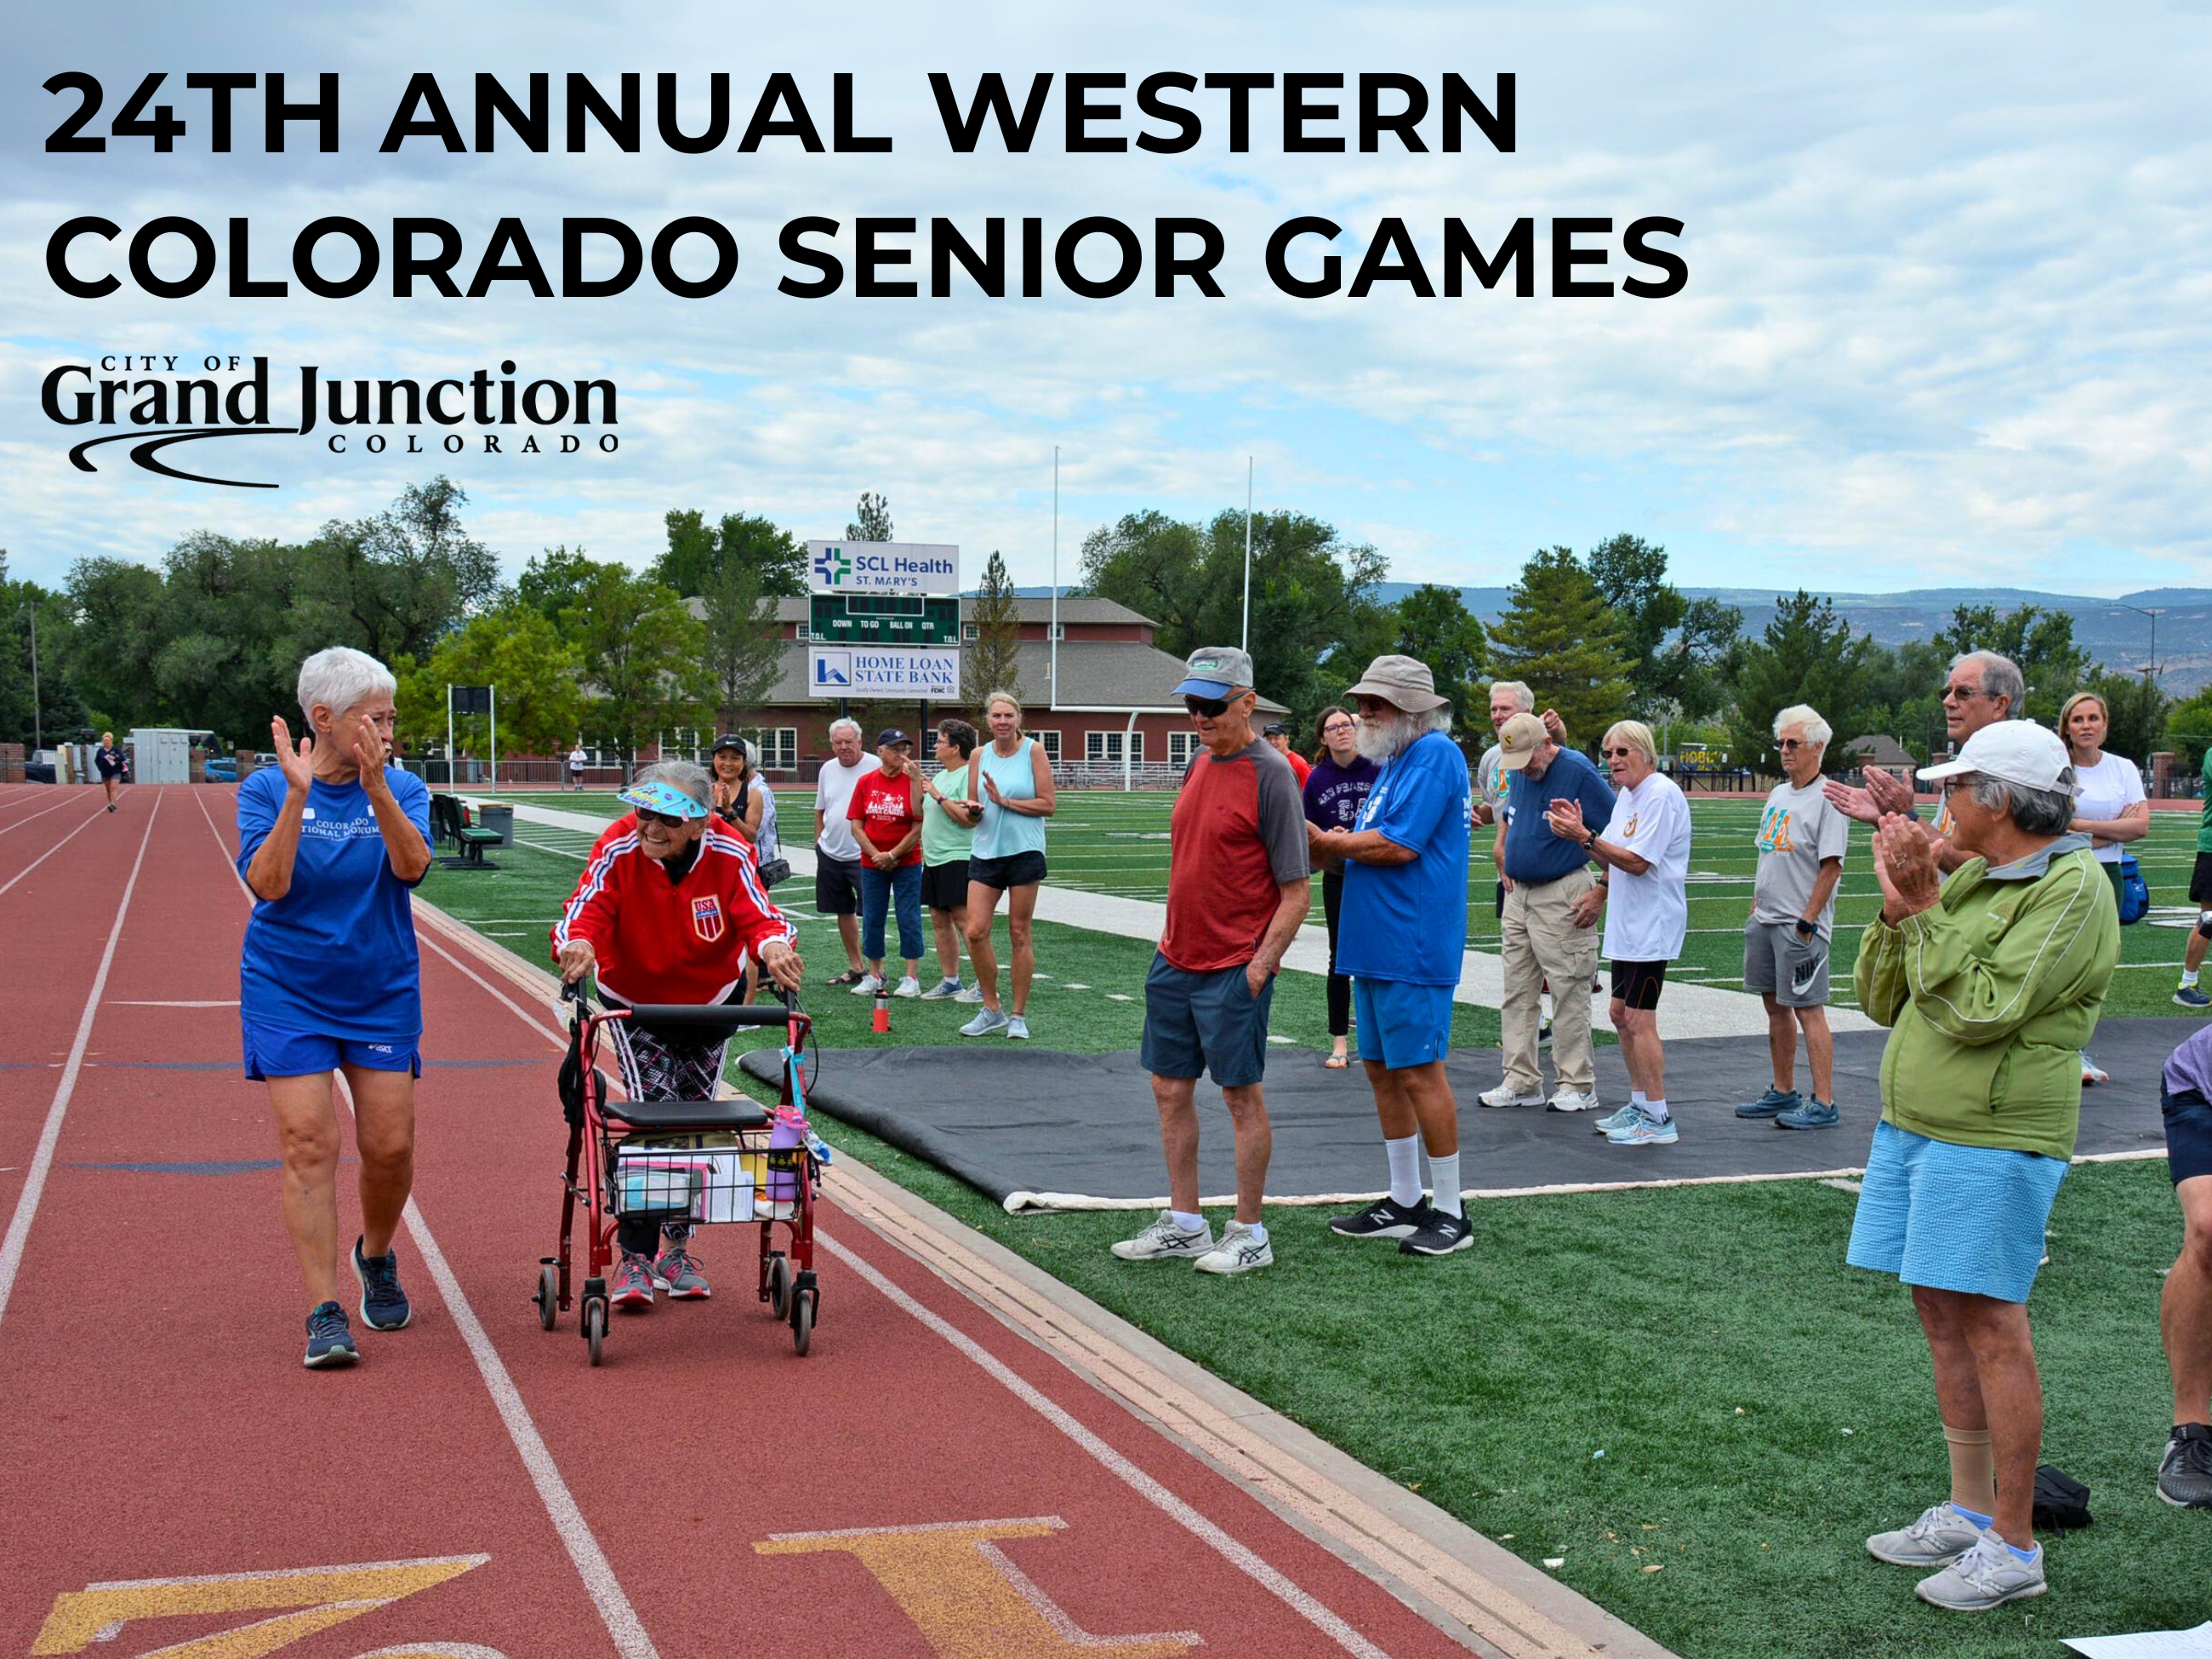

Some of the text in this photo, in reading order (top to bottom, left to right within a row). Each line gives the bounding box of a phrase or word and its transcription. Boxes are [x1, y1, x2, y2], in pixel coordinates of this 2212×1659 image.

[856, 556, 954, 574] SCL Health
[856, 576, 919, 587] ST. MARY'S
[832, 619, 852, 628] DOWN
[921, 622, 934, 630] QTR
[856, 656, 954, 670] HOME LOAN
[855, 670, 954, 684] STATE BANK
[316, 818, 369, 830] COLORADO
[301, 824, 341, 839] TIONAL
[694, 898, 716, 911] USA
